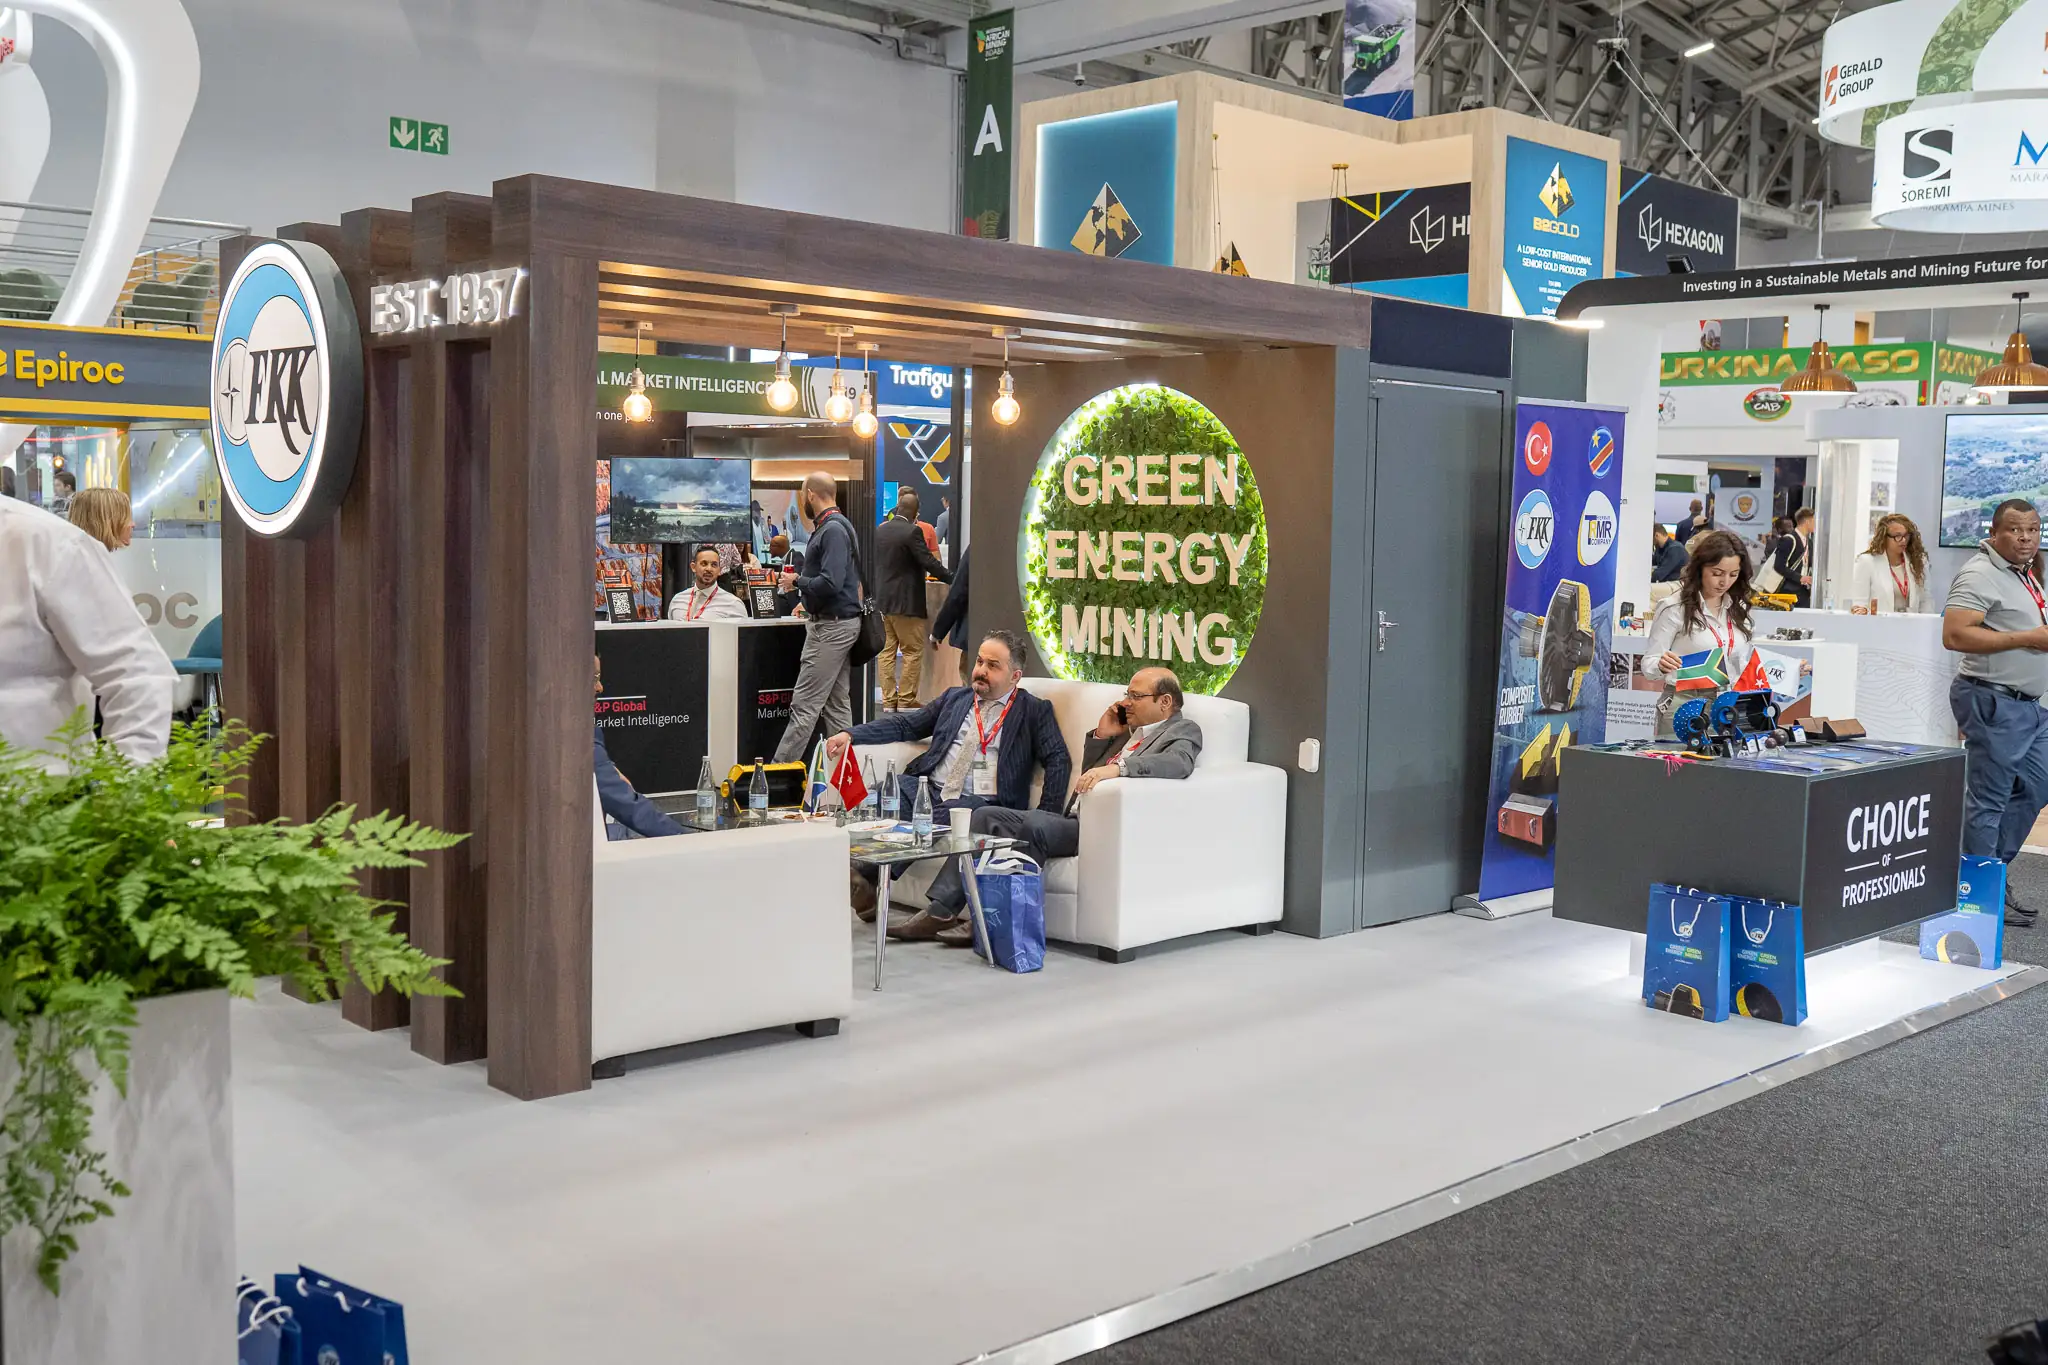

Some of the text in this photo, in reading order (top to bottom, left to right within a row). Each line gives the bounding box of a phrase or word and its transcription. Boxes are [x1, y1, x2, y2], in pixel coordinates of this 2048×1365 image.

[1840, 57, 1883, 80] GERALD
[1839, 78, 1874, 97] GROUP
[973, 103, 1003, 156] A
[1902, 186, 1951, 203] SOREMI
[1664, 221, 1724, 255] HEXAGON
[1522, 245, 1551, 258] LOW-COST
[1552, 250, 1593, 266] INTERNATIONAL
[1543, 261, 1558, 272] GOLD
[1558, 263, 1588, 277] PRODUCER
[1683, 256, 2048, 293] Investing in a Sustainable Metals and Mining Future for
[370, 267, 523, 334] EST. 1957
[15, 349, 125, 388] Epiroc
[611, 371, 672, 389] MAKET
[245, 345, 317, 455] FKK
[604, 411, 623, 421] one
[1063, 454, 1239, 506] GREEN
[1527, 516, 1553, 549] FKK
[1047, 525, 1257, 586] ENERGY
[1061, 604, 1238, 666] MINING
[612, 700, 647, 712] Global
[758, 693, 779, 705] S&P
[1501, 684, 1536, 707] COMPOSITE
[627, 713, 690, 728] Intelligence
[757, 705, 792, 719] Market
[1499, 705, 1525, 726] RUBBER
[1847, 793, 1931, 853] CHOICE
[1881, 853, 1892, 867] OF
[1842, 865, 1926, 908] PROFESSIONALS
